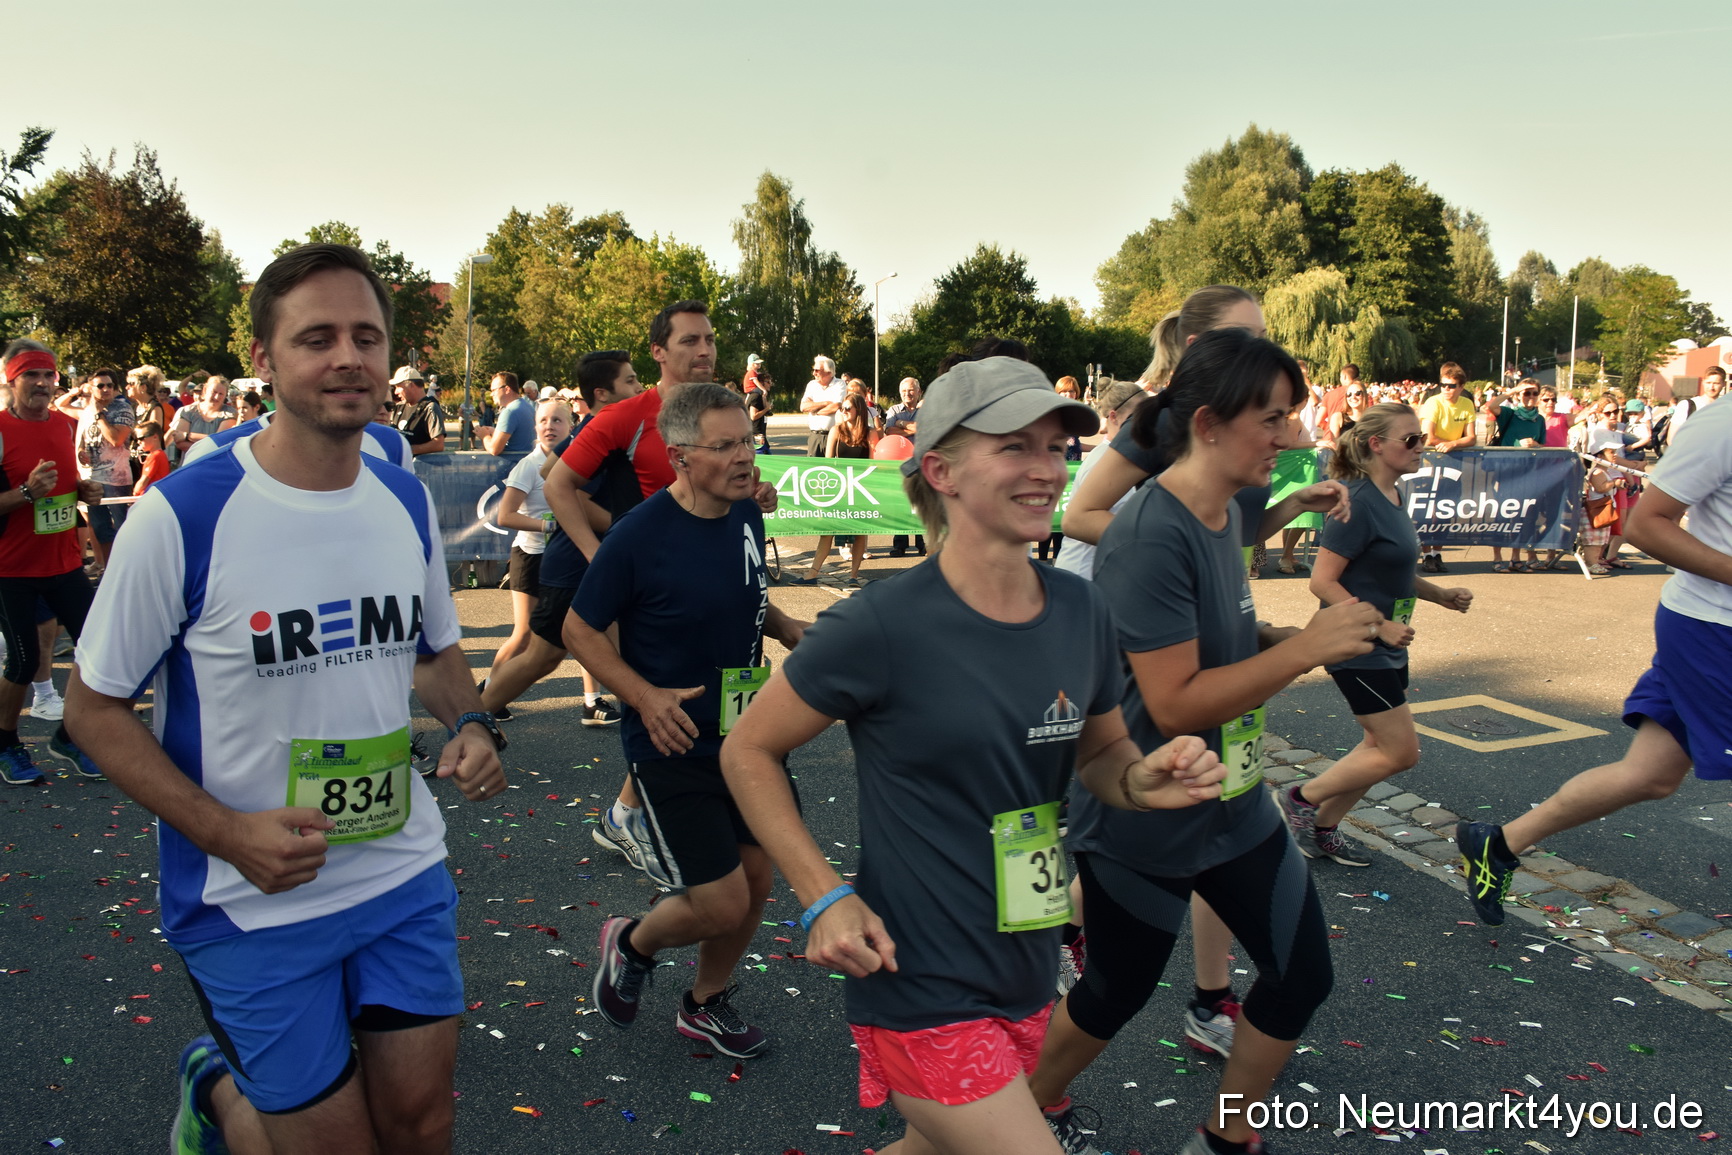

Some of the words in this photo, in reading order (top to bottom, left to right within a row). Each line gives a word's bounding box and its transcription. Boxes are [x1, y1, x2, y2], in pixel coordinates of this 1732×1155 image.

[776, 466, 880, 508] AOK
[42, 505, 74, 524] 1157
[762, 511, 776, 520] ie
[777, 508, 884, 520] Gesundheitskasse.
[1408, 491, 1537, 520] Fischer
[1416, 522, 1524, 534] AUTOMOBILE
[256, 661, 318, 679] Leading
[325, 650, 374, 668] FILTER
[321, 770, 394, 816] 834
[335, 817, 365, 829] erger
[366, 808, 400, 823] Andreas
